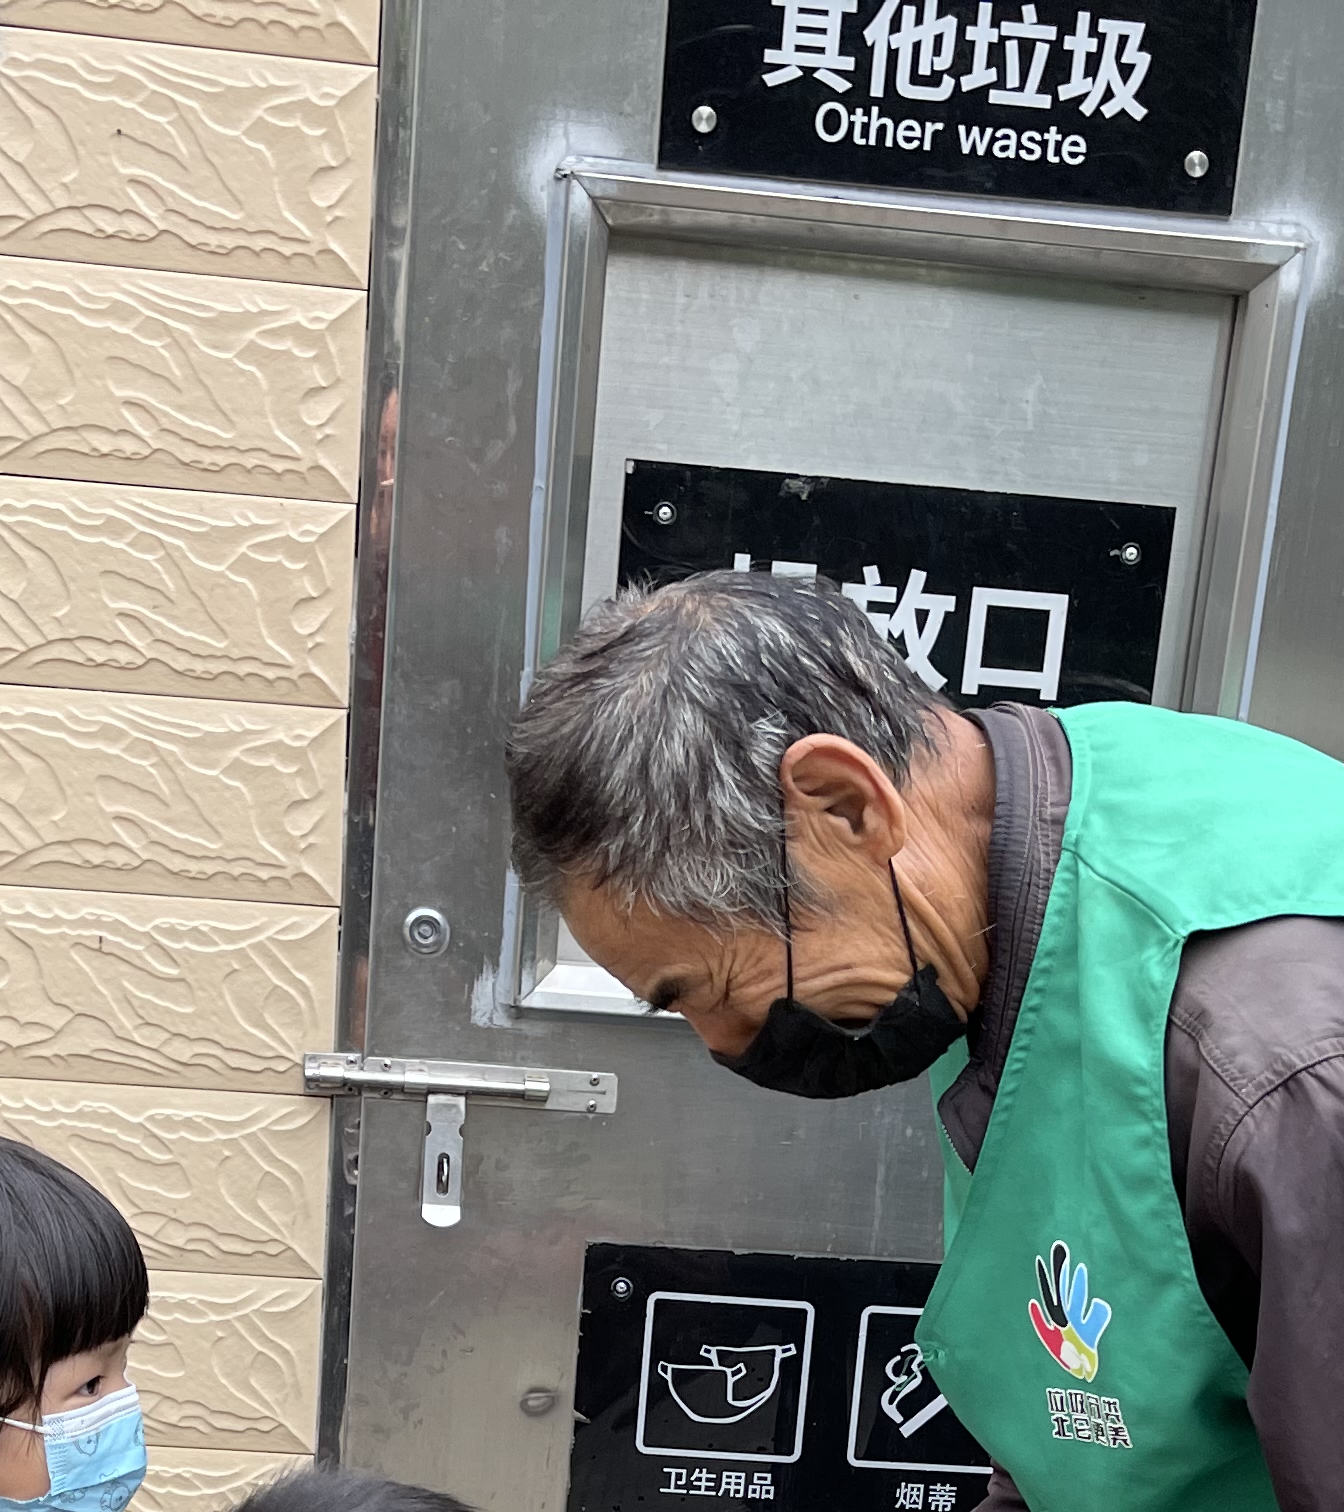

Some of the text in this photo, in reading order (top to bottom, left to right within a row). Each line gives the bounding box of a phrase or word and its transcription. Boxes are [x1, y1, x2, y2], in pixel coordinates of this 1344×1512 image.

[762, 0, 1151, 122] 其他垃圾
[815, 103, 1088, 166] Other waste
[734, 553, 1069, 701] 放口
[659, 1467, 775, 1500] 卫生用品
[894, 1481, 958, 1512] 烟蒂
